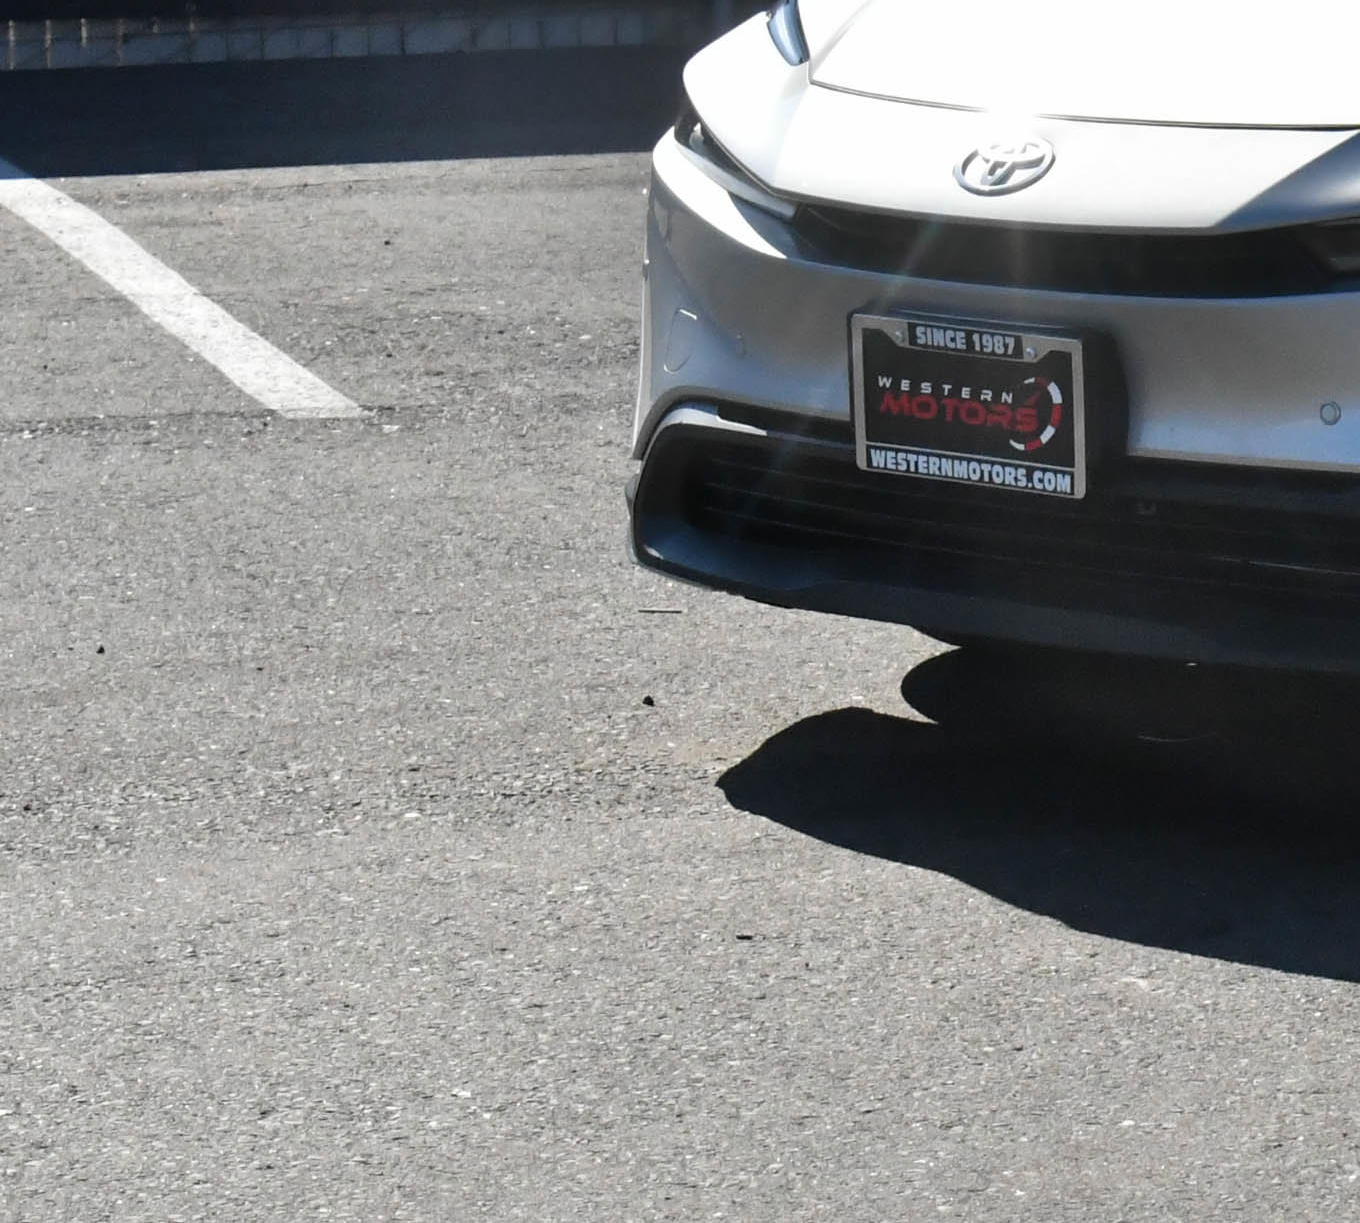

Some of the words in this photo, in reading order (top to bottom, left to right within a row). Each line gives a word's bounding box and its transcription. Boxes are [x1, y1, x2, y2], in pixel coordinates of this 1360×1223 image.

[916, 326, 966, 350] SINCE
[972, 334, 1015, 354] 1987
[878, 376, 1013, 404] WESTERN
[880, 392, 1038, 433] MOTORS
[870, 448, 1072, 494] WESTERNMOTORS.COM
